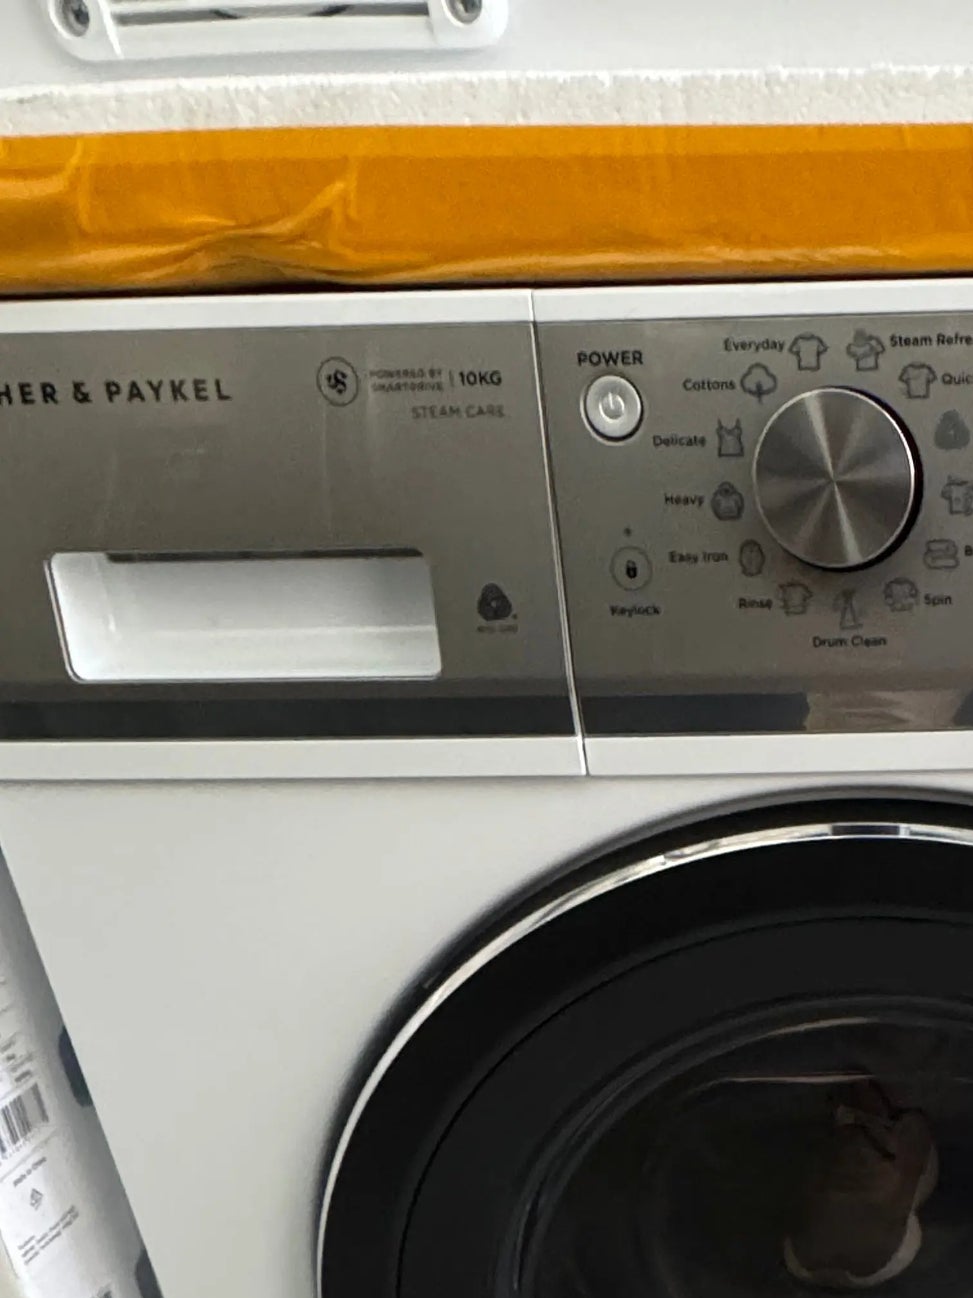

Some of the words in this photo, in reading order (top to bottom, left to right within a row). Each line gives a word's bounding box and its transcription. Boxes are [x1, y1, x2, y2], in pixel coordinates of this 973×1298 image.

[724, 337, 785, 354] Everyday
[890, 334, 933, 347] Steam
[577, 350, 643, 367] POWER
[459, 370, 502, 386] 10KG
[683, 378, 736, 391] Cottons
[72, 380, 93, 404] &
[104, 378, 233, 402] PAYKEL
[411, 405, 461, 419] STEAM
[465, 405, 506, 419] CARE
[653, 434, 706, 447] Delicate
[664, 493, 705, 507] Heavy
[669, 551, 698, 563] Easy
[703, 551, 728, 562] Iron
[739, 597, 773, 610] Rinse
[923, 594, 952, 607] Spin
[610, 604, 660, 618] Keylock
[813, 636, 847, 648] Drum
[851, 635, 887, 647] Clean
